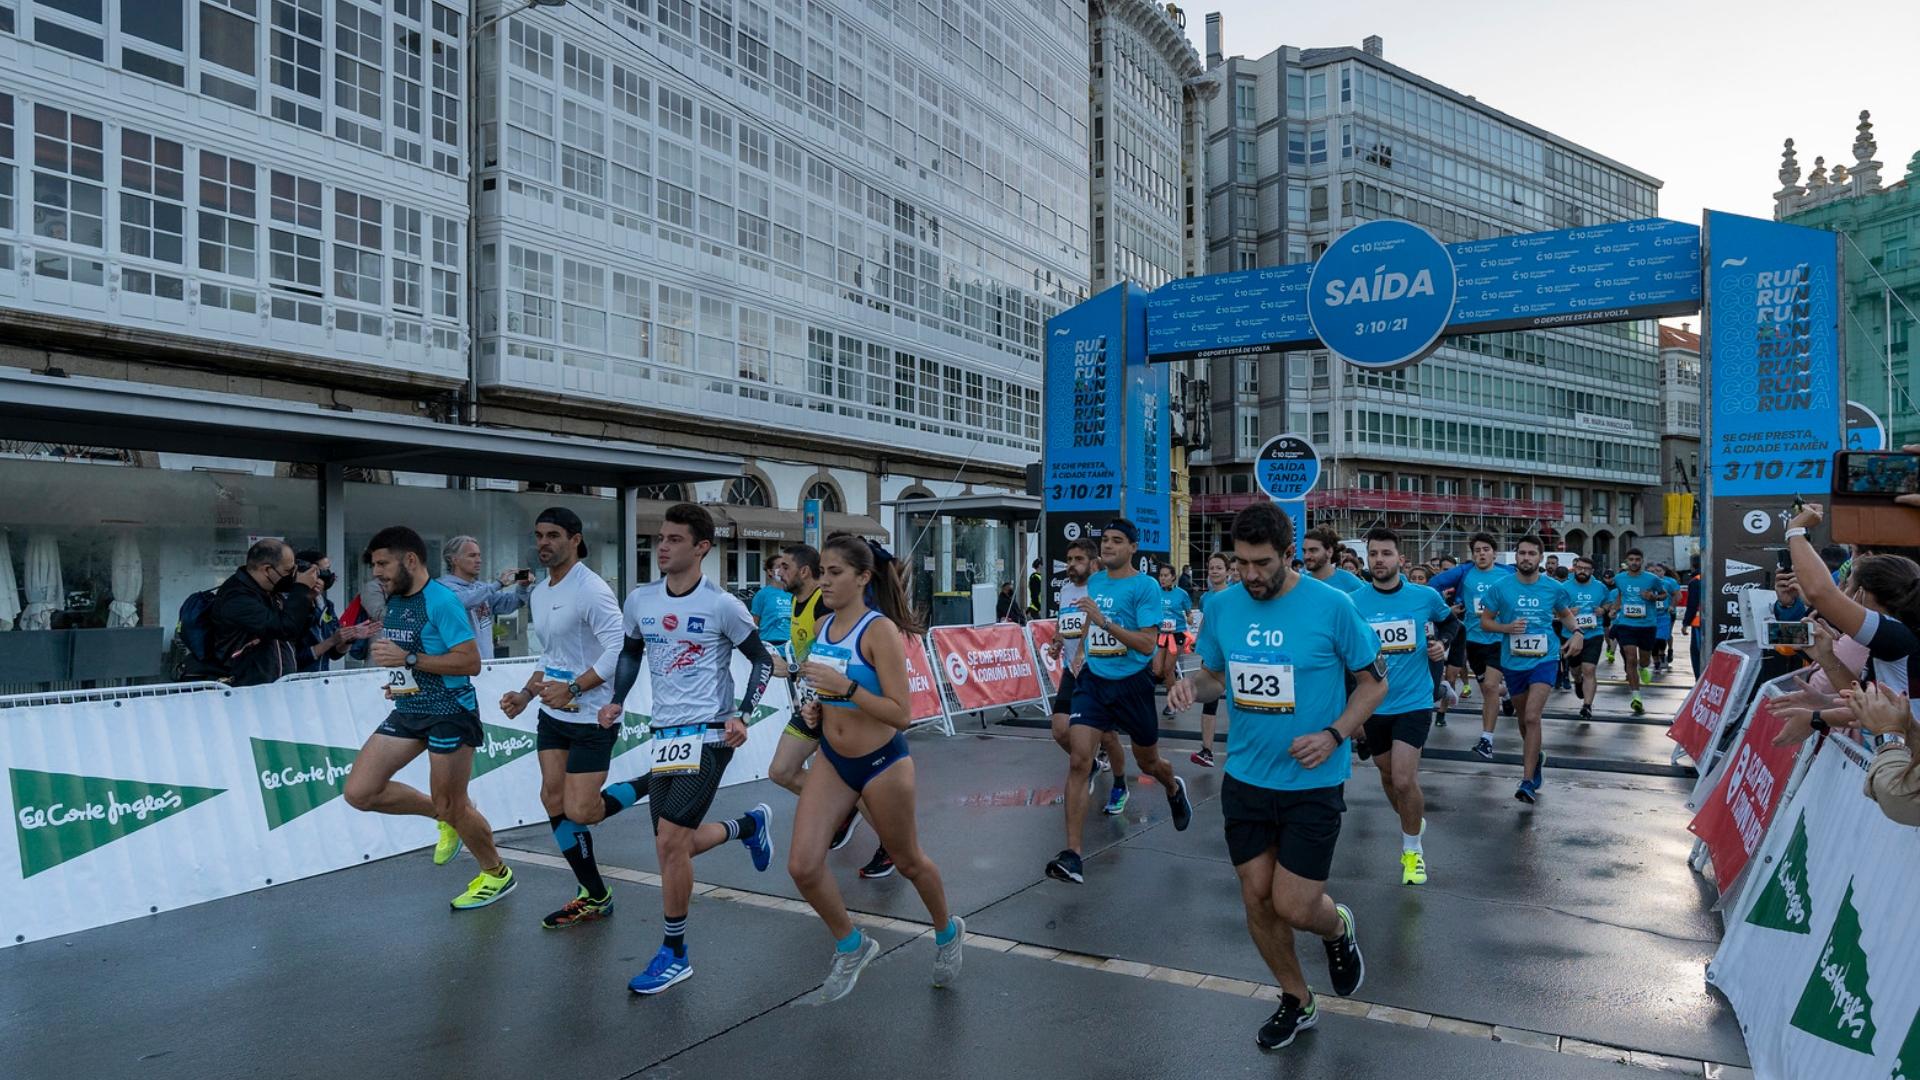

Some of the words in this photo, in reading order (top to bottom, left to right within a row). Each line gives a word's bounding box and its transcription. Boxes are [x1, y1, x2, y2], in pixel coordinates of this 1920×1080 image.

[1325, 264, 1435, 306] SAÍDA
[1604, 309, 1629, 317] VOLTA
[1355, 318, 1408, 335] 3/10/21
[1270, 460, 1306, 471] SAÍDA
[1723, 459, 1826, 481] 3/10/21
[1267, 473, 1307, 482] TANDA
[1052, 484, 1113, 500] 3/10/21
[1061, 618, 1081, 631] 156
[1576, 616, 1593, 625] 136
[1091, 632, 1117, 647] 116
[1515, 638, 1541, 650] 117
[909, 672, 930, 693] MÉN
[1237, 672, 1280, 697] 123
[487, 734, 534, 759] Inglés
[656, 743, 692, 763] 103
[262, 770, 281, 790] El
[281, 767, 326, 786] Corte
[19, 806, 48, 830] El
[47, 802, 105, 826] Corte
[105, 791, 182, 824] Inglés
